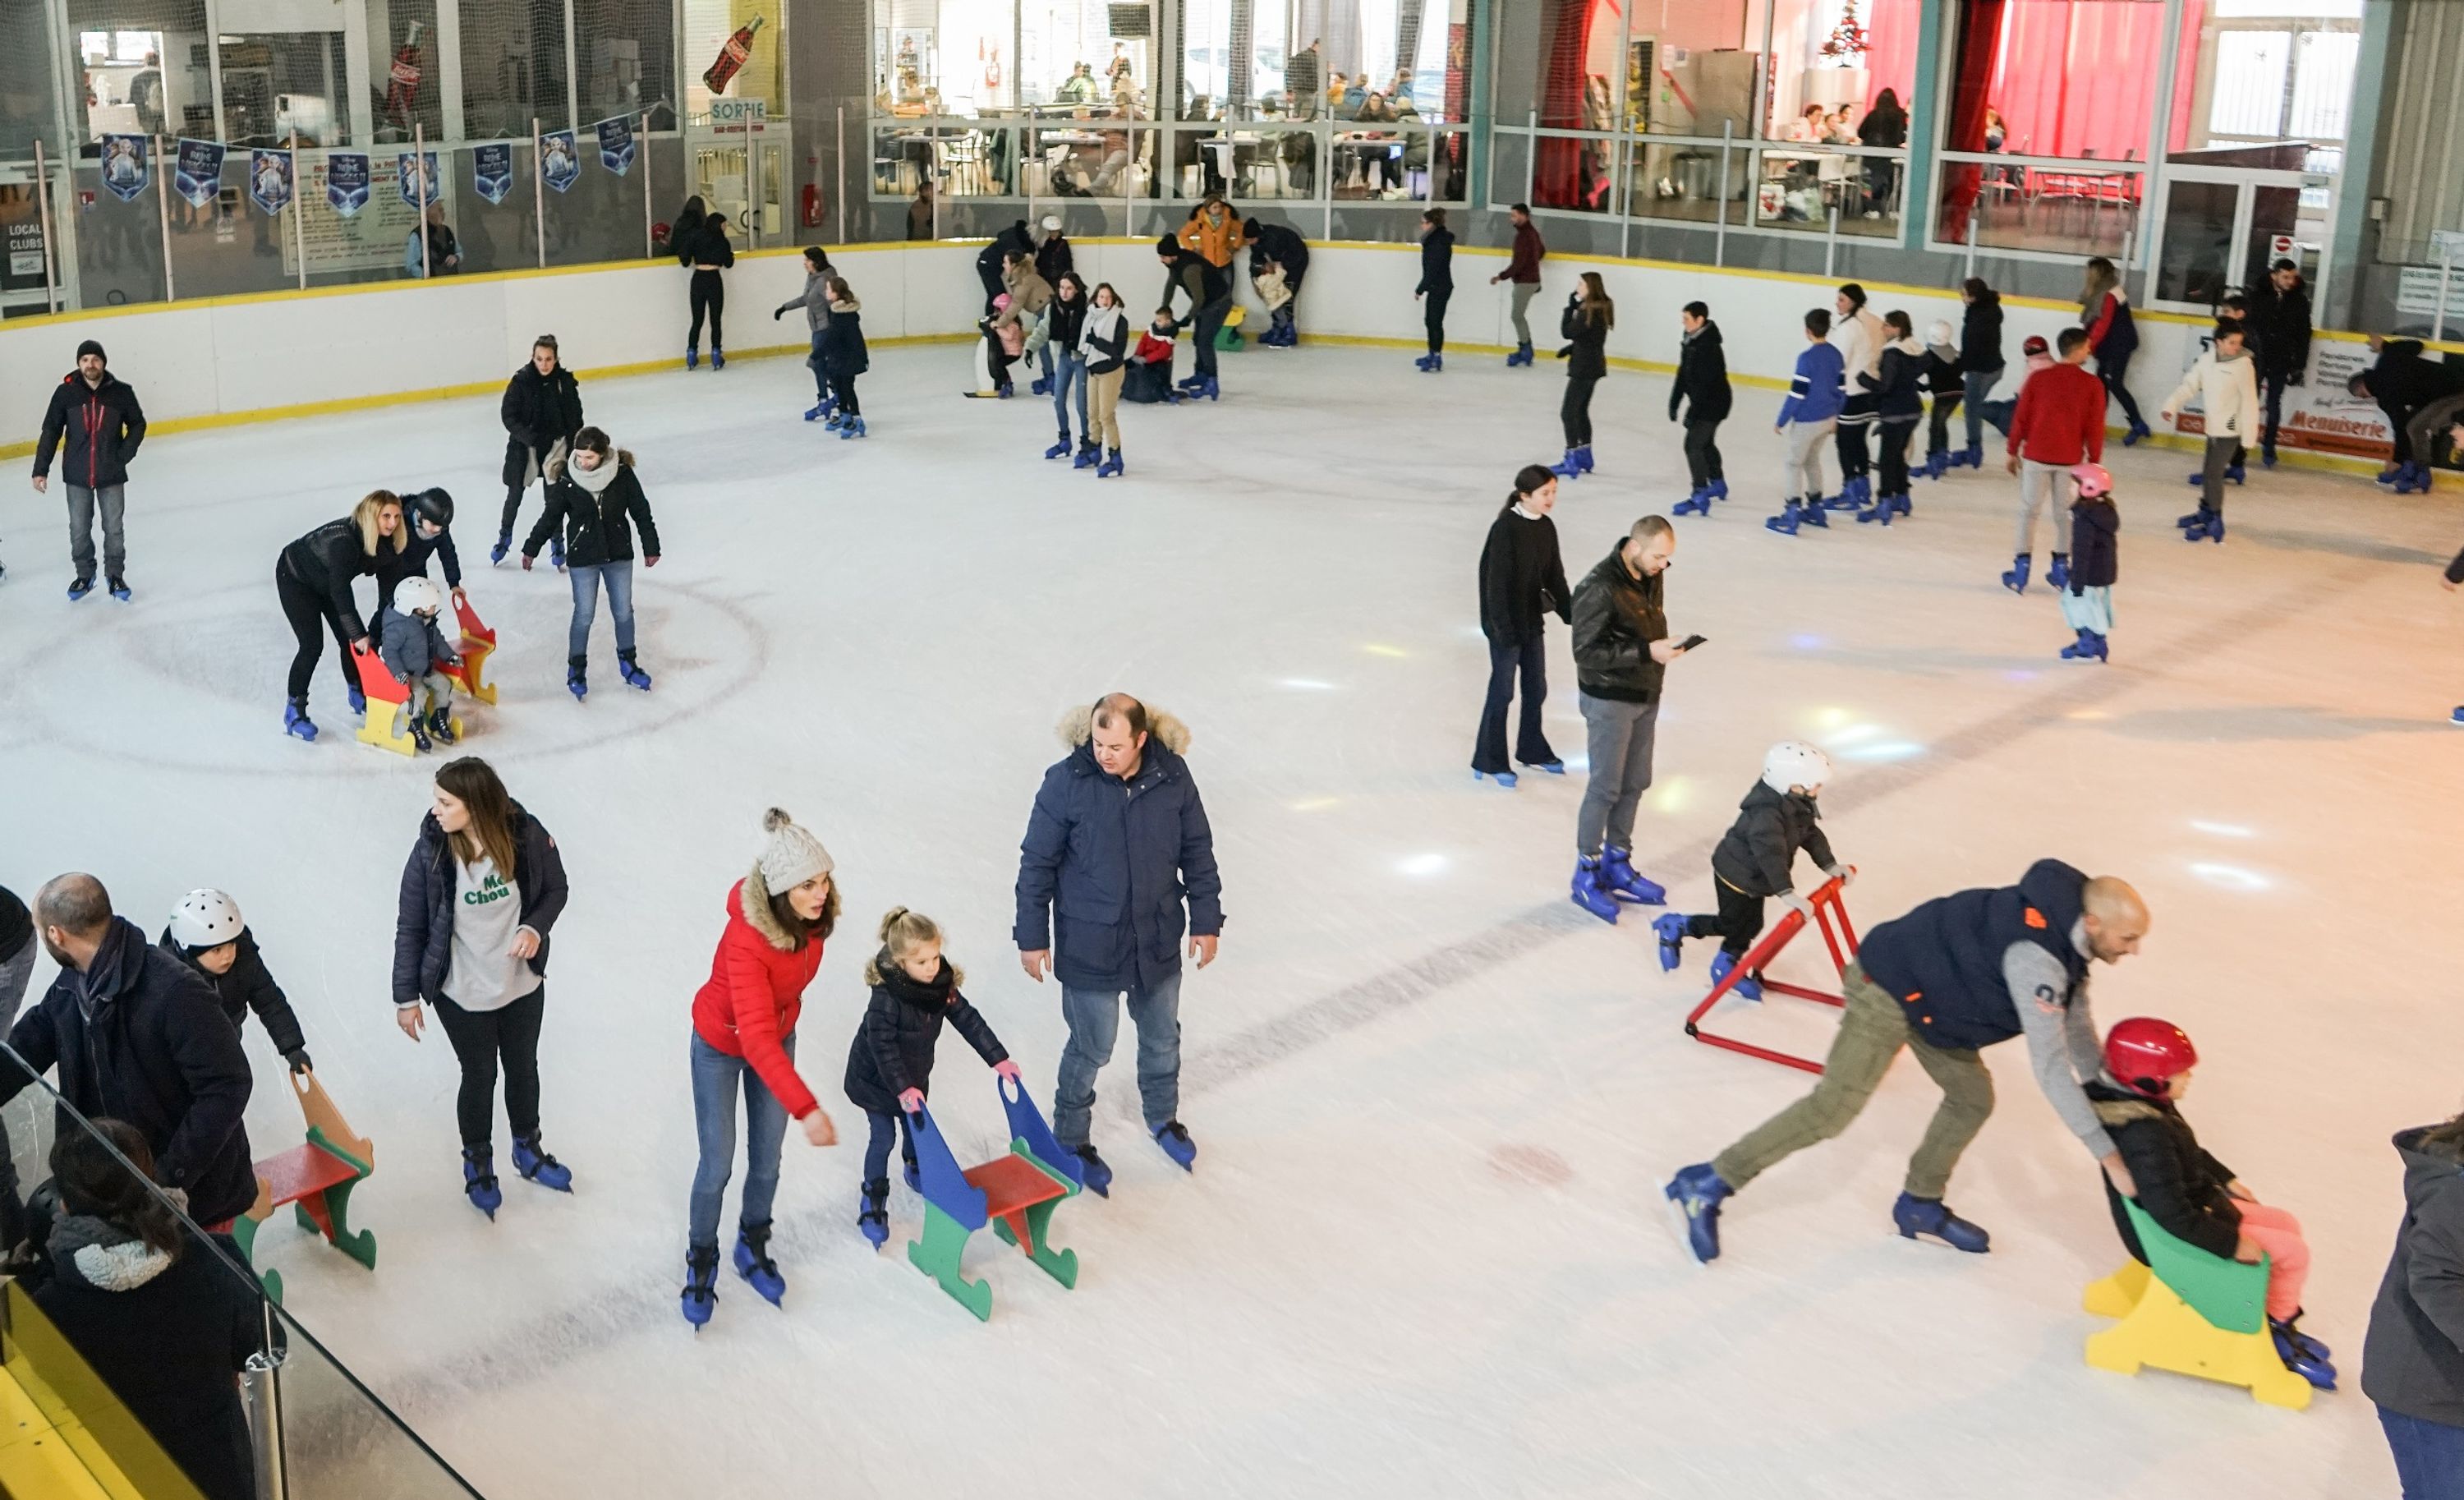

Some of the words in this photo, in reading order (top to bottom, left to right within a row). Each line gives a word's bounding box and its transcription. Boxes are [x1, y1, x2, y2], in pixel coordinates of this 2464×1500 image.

[9, 223, 42, 236] LOCAL
[10, 237, 44, 250] CLUBS
[2288, 410, 2387, 439] Menuiserie
[464, 886, 510, 904] Chou
